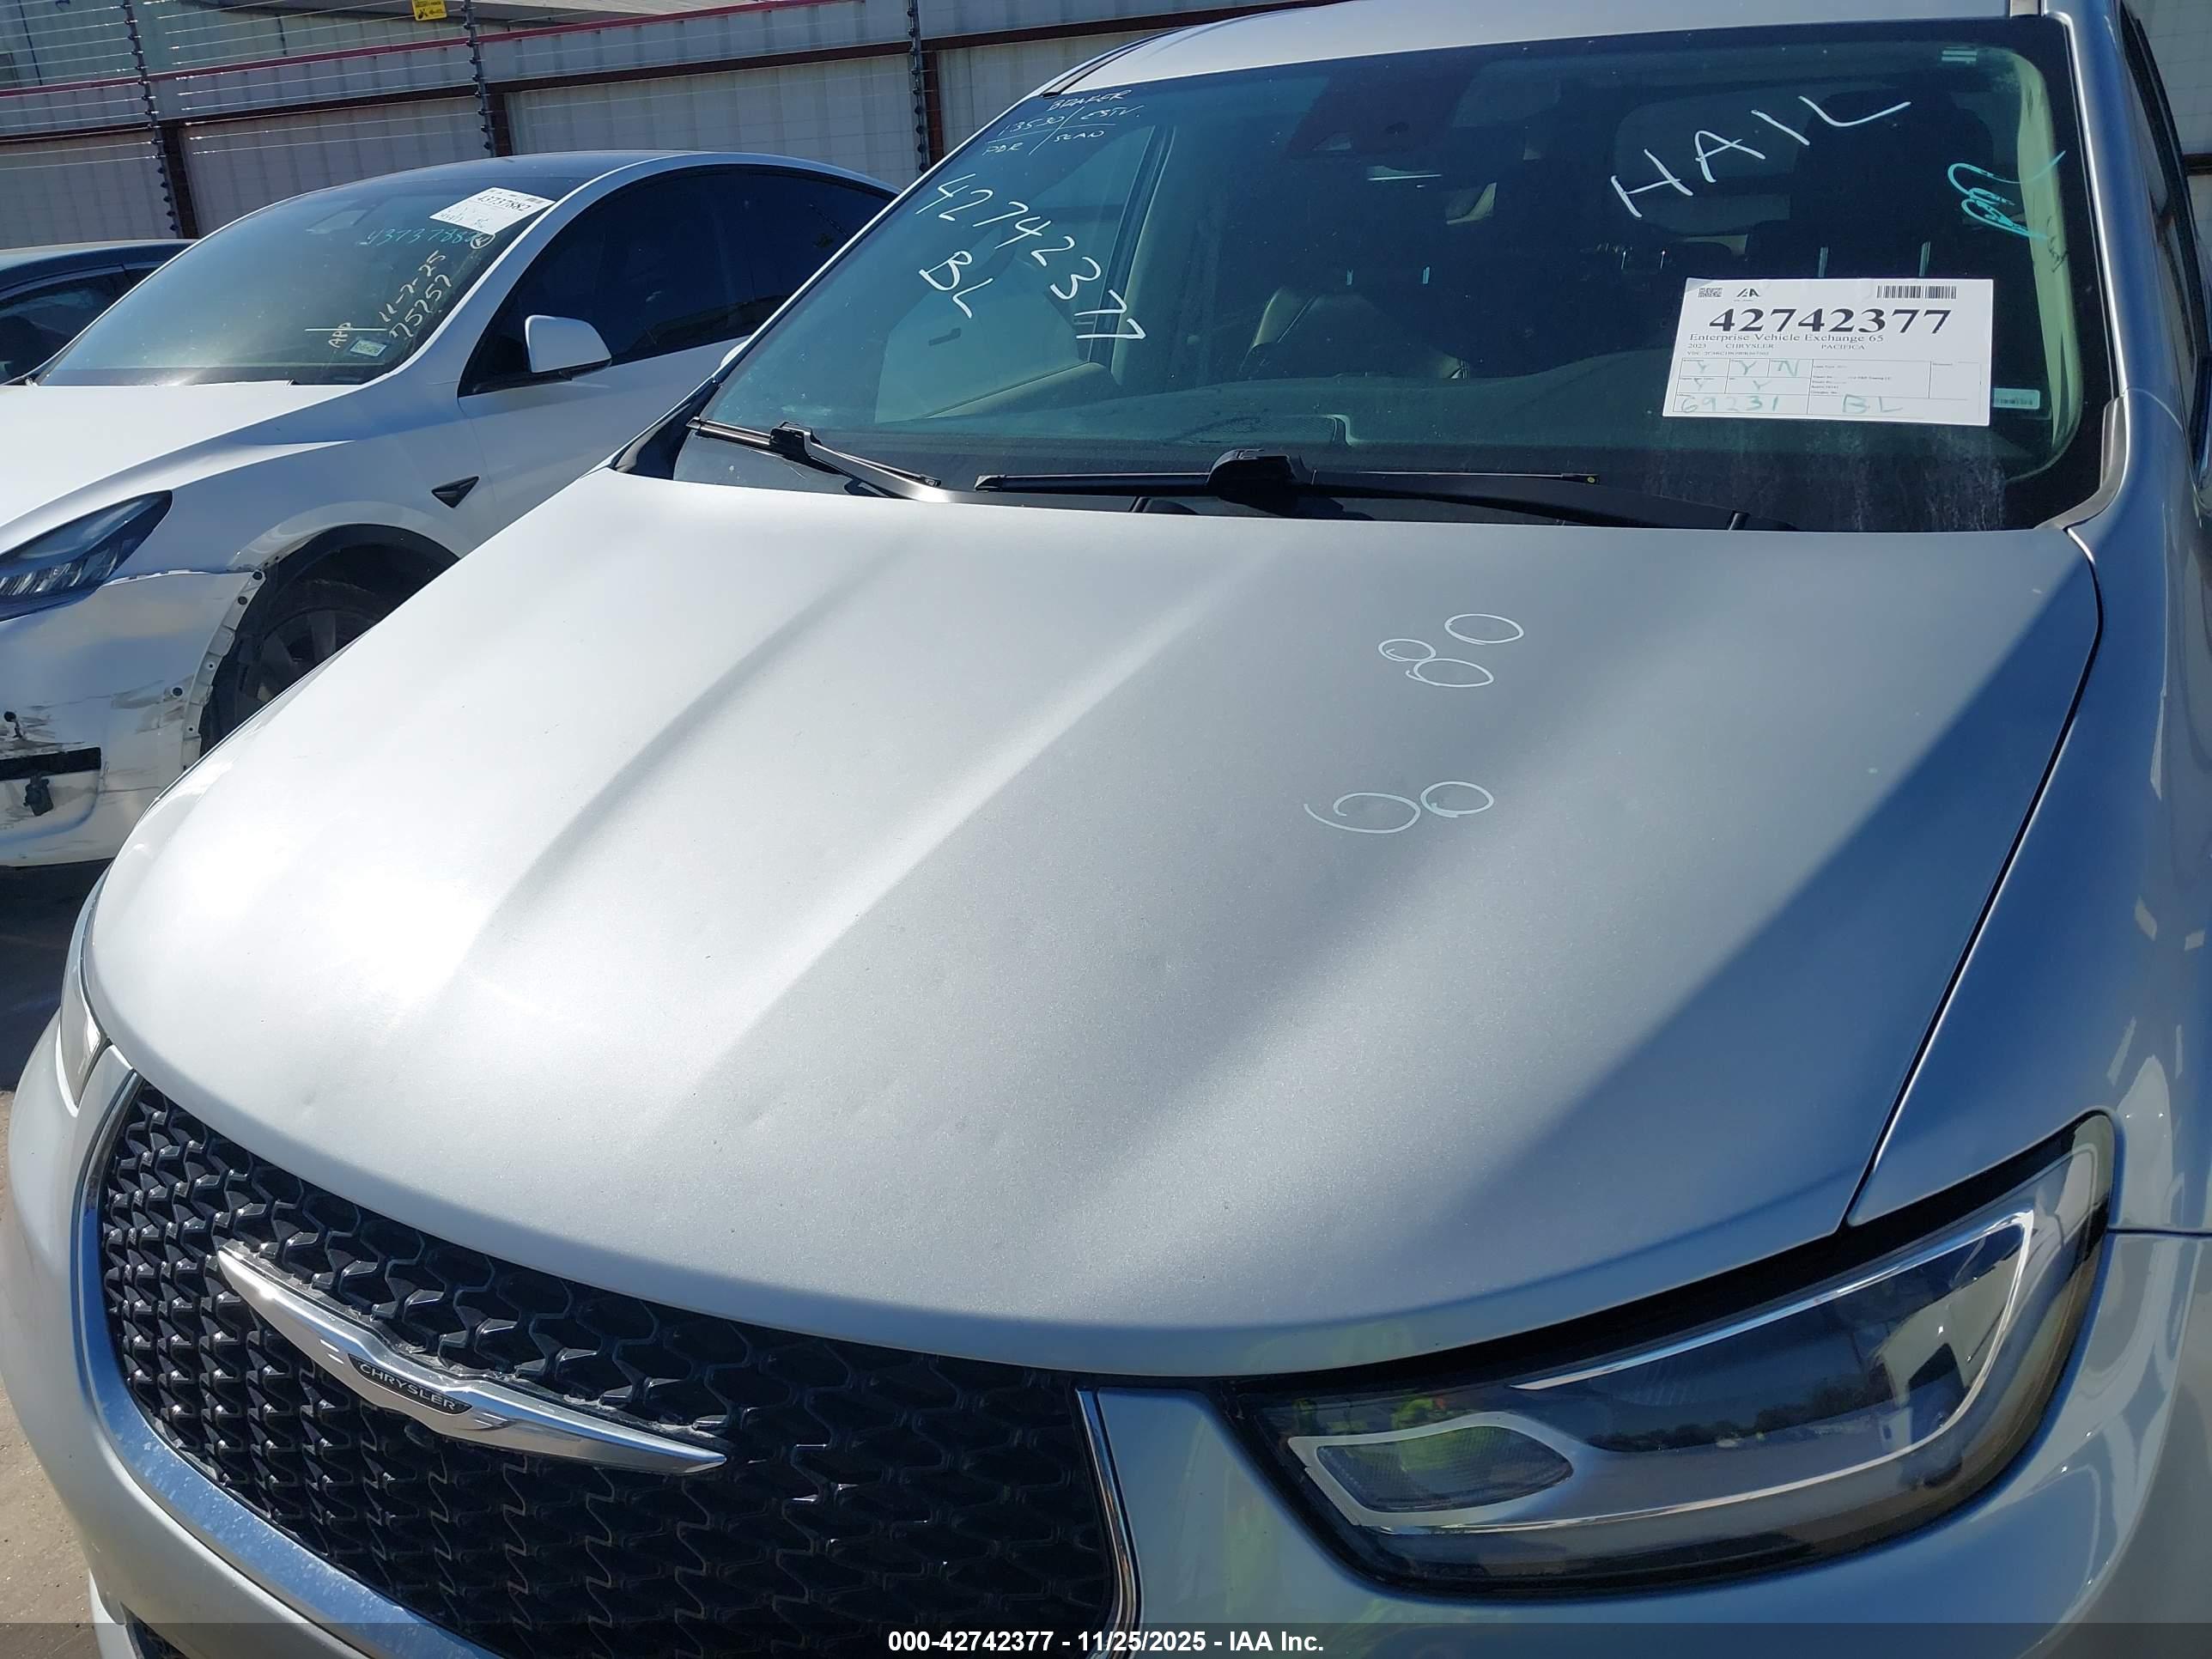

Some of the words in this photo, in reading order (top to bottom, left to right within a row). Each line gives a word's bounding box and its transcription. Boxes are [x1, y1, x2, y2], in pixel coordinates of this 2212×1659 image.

[1610, 95, 1911, 218] HAIL
[915, 173, 1147, 340] 42742377
[919, 250, 994, 319] BL
[1689, 332, 1749, 343] Enterprise
[1754, 333, 1801, 342] Vehicle
[1804, 333, 1865, 343] Exchange
[1869, 334, 1884, 343] 65
[1709, 307, 1953, 335] 42742377
[1741, 360, 1758, 375] Y
[1680, 395, 1779, 413] 69231
[359, 1363, 455, 1411] CHRYSLER
